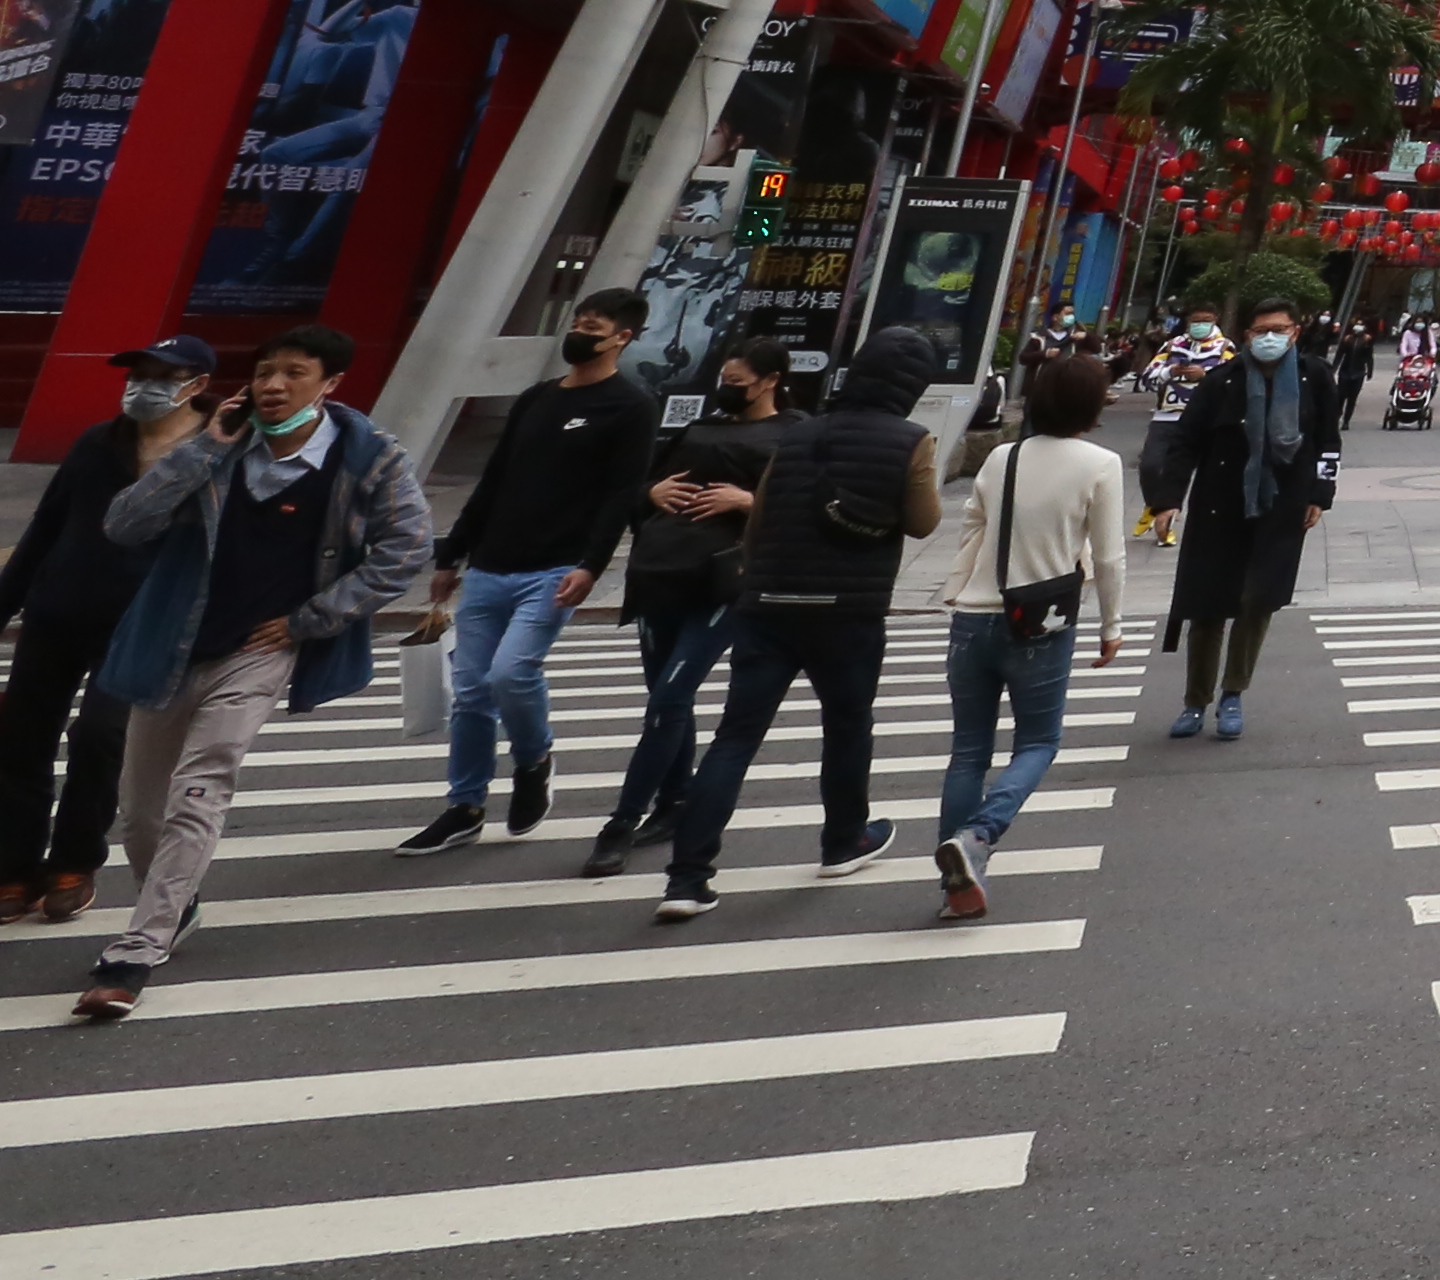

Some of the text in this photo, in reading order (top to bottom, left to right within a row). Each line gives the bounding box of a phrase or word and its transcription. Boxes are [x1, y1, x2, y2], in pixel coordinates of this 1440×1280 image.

[44, 120, 128, 149] 中華
[760, 173, 784, 198] 19
[17, 196, 98, 223] 指定
